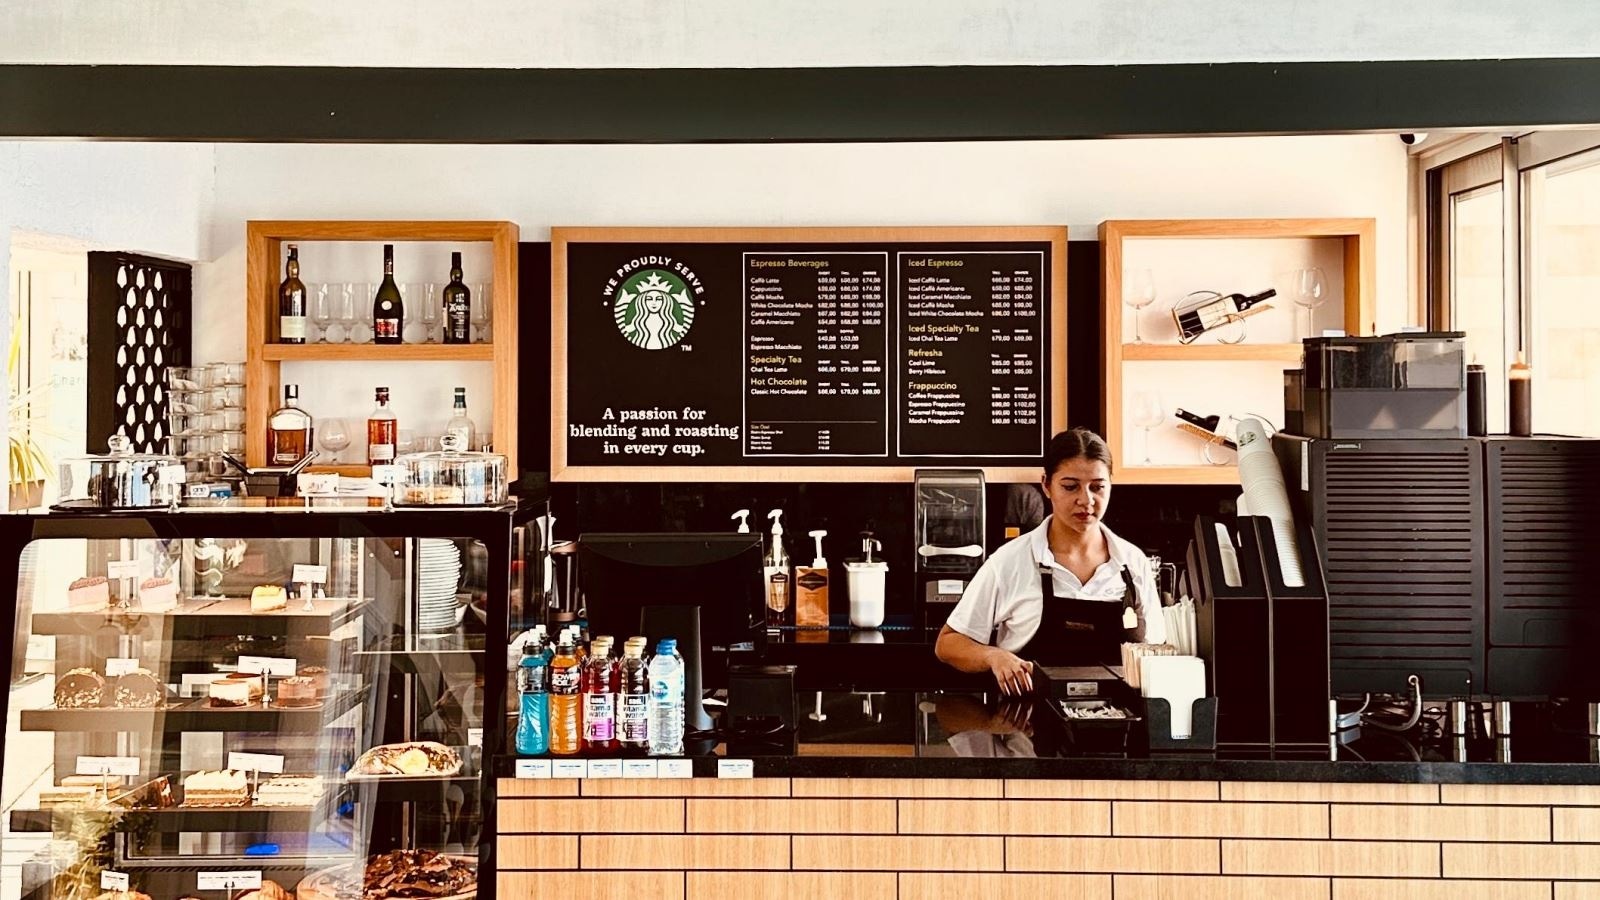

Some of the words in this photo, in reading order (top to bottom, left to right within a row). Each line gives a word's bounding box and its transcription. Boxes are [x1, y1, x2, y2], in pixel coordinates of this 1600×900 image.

[750, 259, 786, 269] Espresso
[788, 259, 829, 269] Beverages
[908, 259, 925, 267] Iced
[927, 259, 963, 269] Espresso
[603, 277, 618, 297] WE
[616, 255, 672, 278] PROUDLY
[674, 261, 705, 296] SERVE
[908, 325, 925, 333] Iced
[927, 324, 963, 334] Specialty
[965, 325, 979, 333] Tea
[908, 349, 943, 357] Refresha
[750, 356, 786, 365] Specialty
[788, 356, 802, 364] Tea
[750, 378, 766, 386] Hot
[767, 378, 808, 386] Chocolate
[908, 382, 957, 391] Frappuccino
[602, 408, 615, 420] A
[620, 407, 678, 423] passion
[682, 407, 706, 420] for
[570, 424, 637, 440] blending
[641, 424, 670, 437] and
[675, 425, 739, 440] roasting
[603, 442, 619, 454] in
[624, 444, 668, 457] every
[673, 444, 705, 457] cup.
